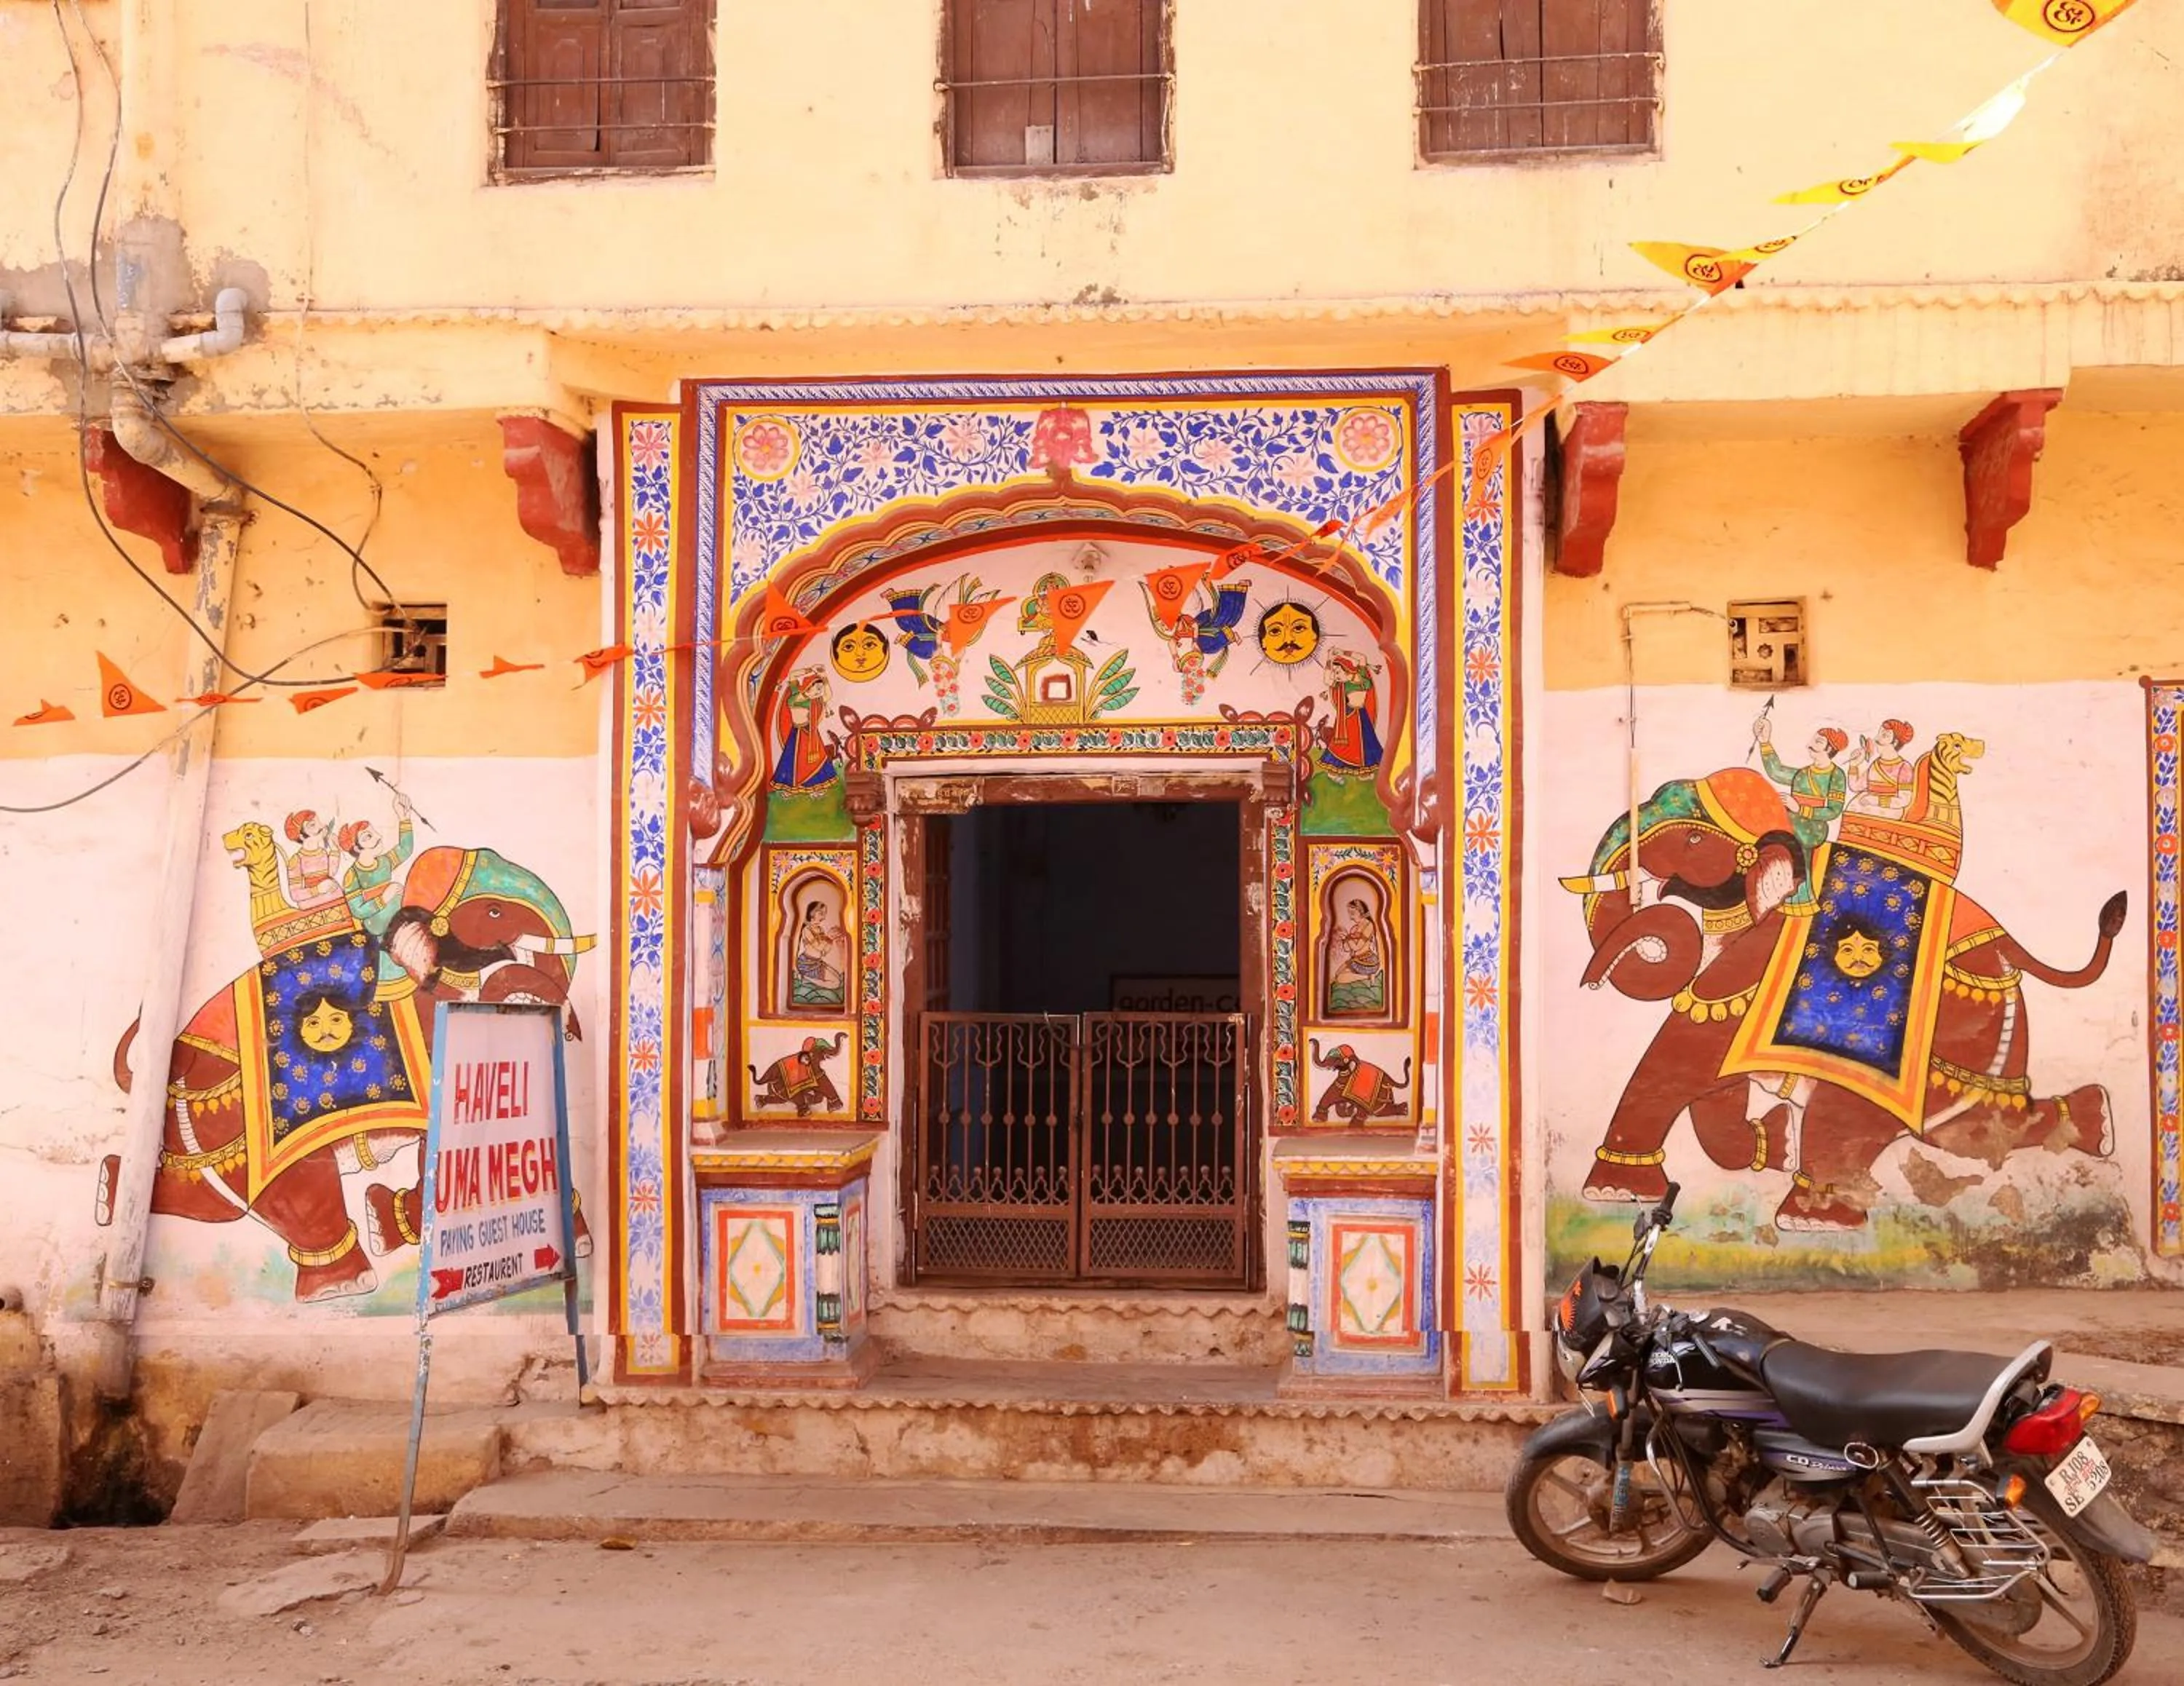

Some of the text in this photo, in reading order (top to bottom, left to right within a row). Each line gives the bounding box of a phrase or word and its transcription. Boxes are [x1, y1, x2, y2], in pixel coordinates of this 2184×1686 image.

[454, 1061, 529, 1125] HAVELI
[435, 1137, 558, 1213] UMA MEGH
[440, 1208, 546, 1257] PAYING GUEST HOUSE
[464, 1253, 523, 1289] RESTAURENT
[1786, 1455, 1810, 1466] CD
